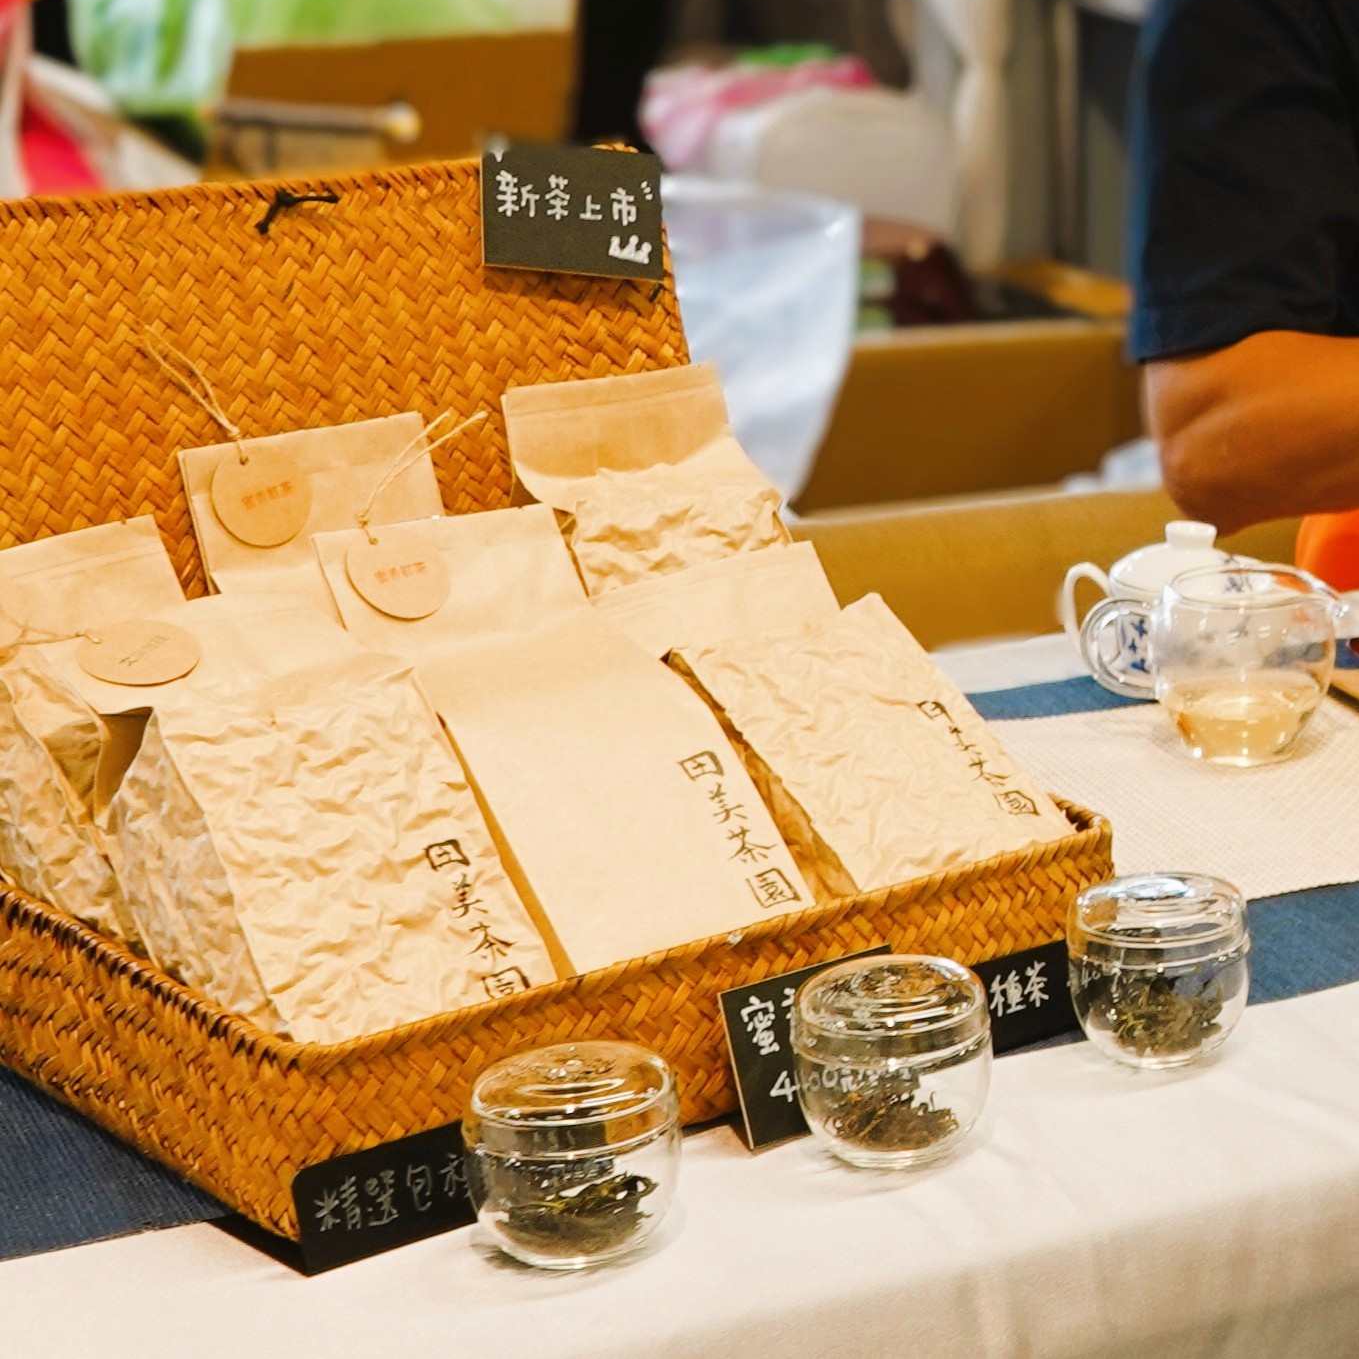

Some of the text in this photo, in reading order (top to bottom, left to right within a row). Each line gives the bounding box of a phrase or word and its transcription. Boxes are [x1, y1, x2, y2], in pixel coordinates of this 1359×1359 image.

[495, 169, 638, 226] 新茶上市
[677, 750, 803, 909] 田美茶園
[740, 986, 797, 1056] 蜜
